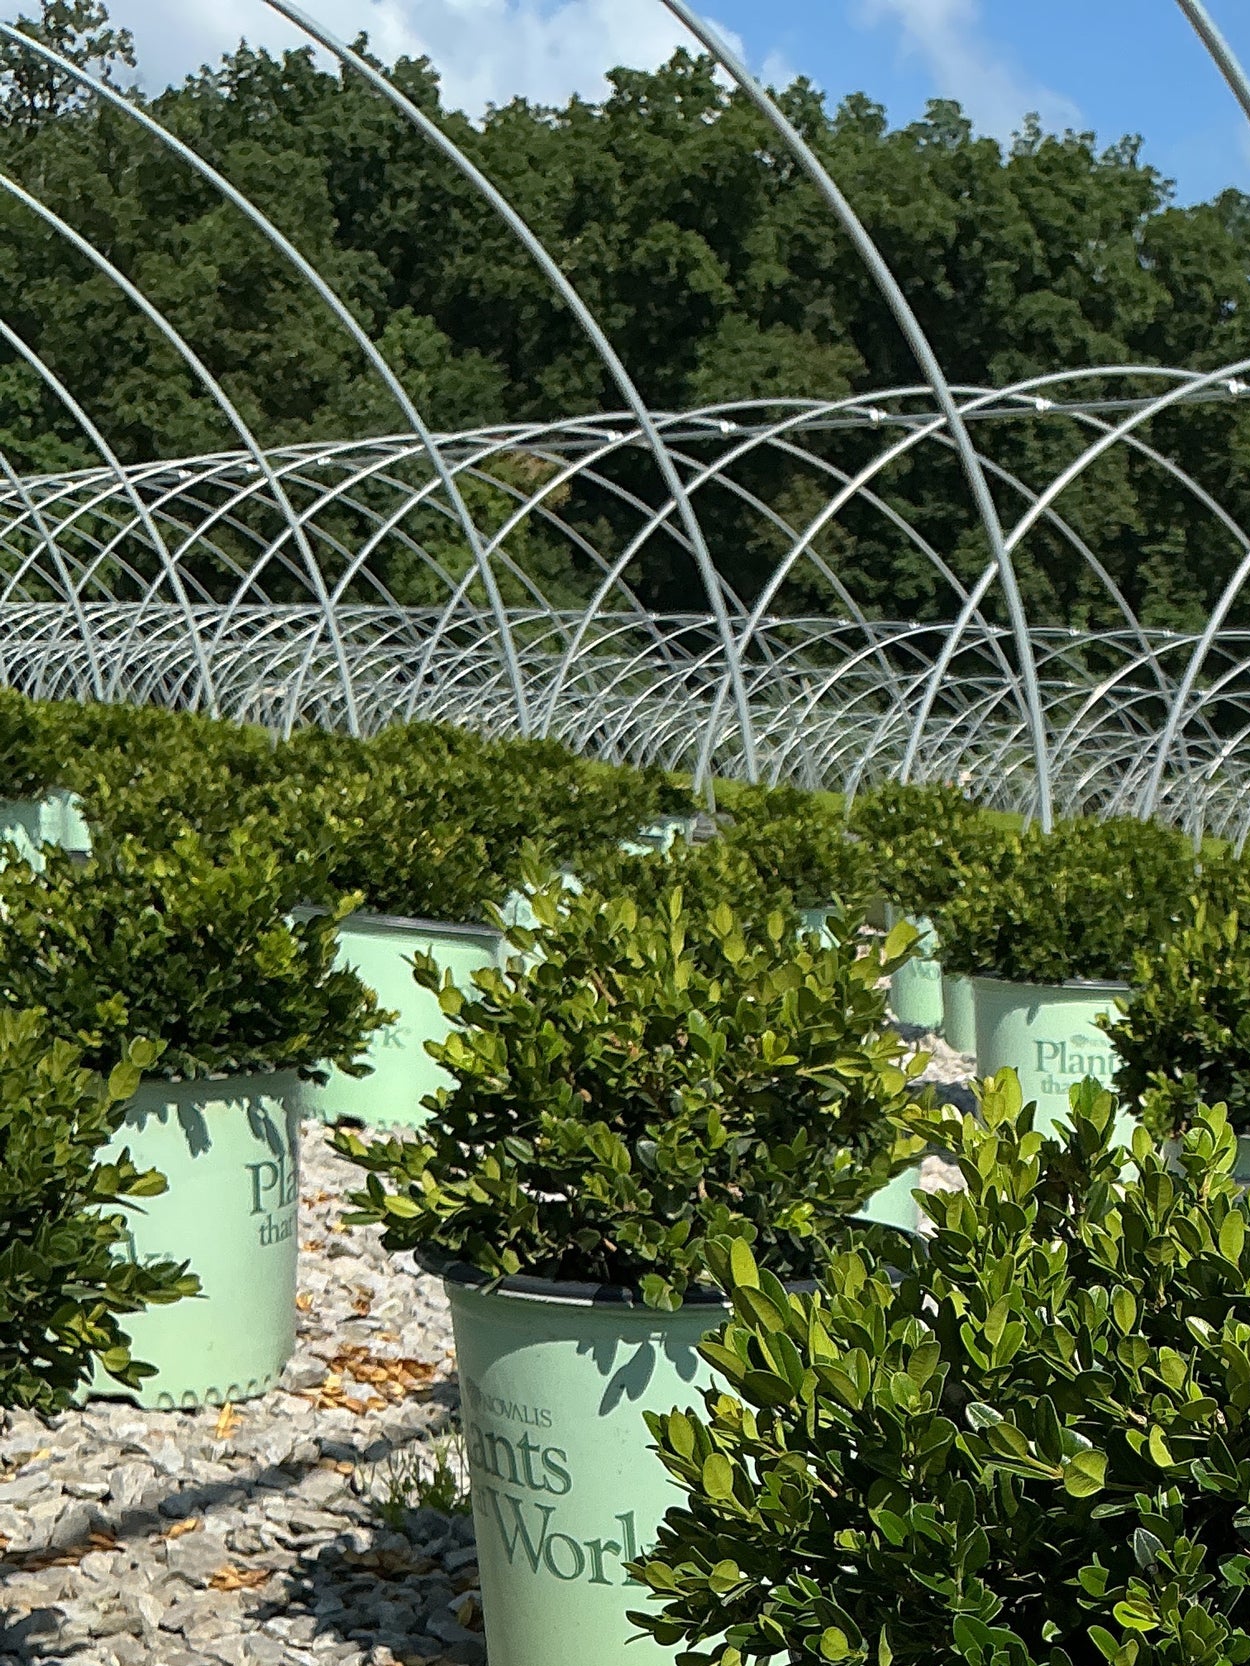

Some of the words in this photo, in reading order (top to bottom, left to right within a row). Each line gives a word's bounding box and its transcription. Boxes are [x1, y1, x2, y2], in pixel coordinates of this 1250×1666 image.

[1034, 1040, 1115, 1074] Plant
[245, 1154, 299, 1214] Pla
[470, 1422, 572, 1495] ants
